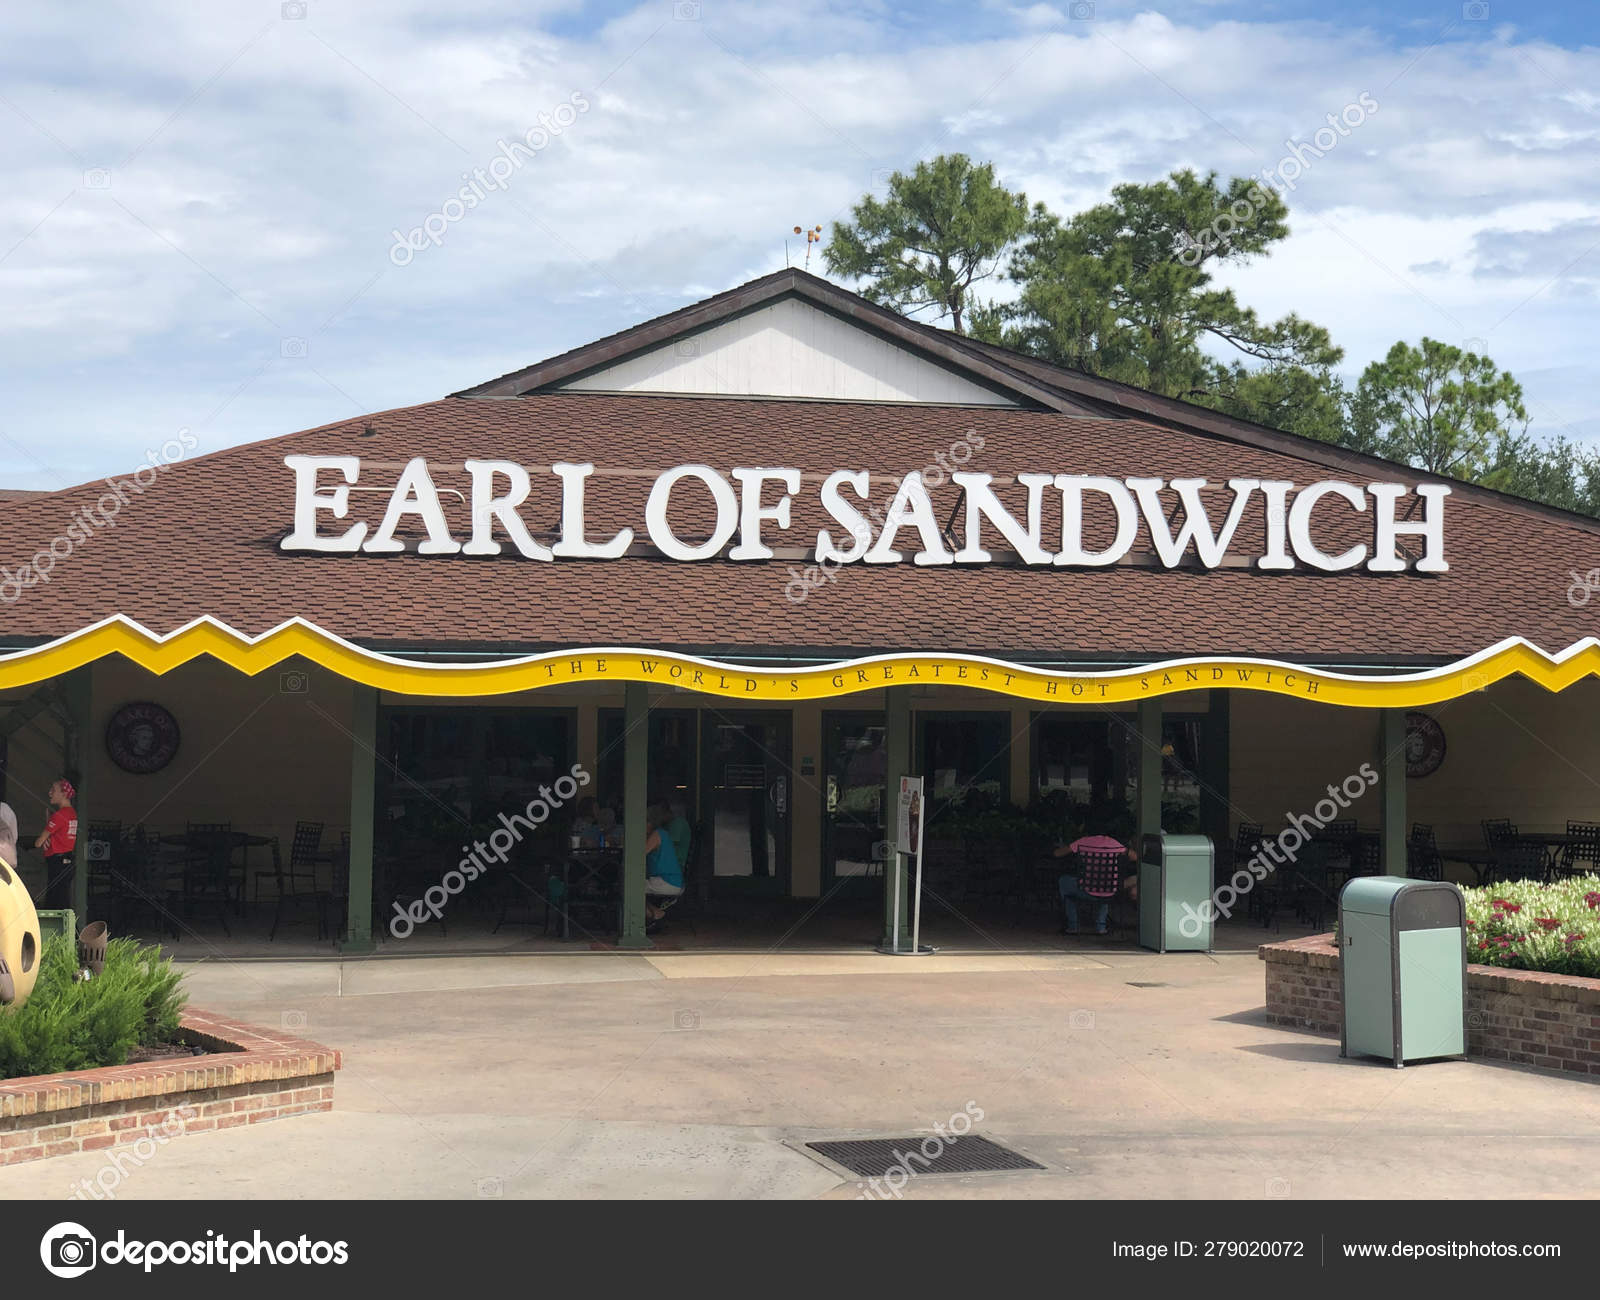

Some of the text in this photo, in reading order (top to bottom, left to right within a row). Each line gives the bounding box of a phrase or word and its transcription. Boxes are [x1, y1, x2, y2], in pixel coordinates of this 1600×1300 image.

[280, 454, 1452, 572] EARL OF SANDWICH
[544, 658, 1321, 697] THE WORLD'S GREATEST HOT SANDWICH
